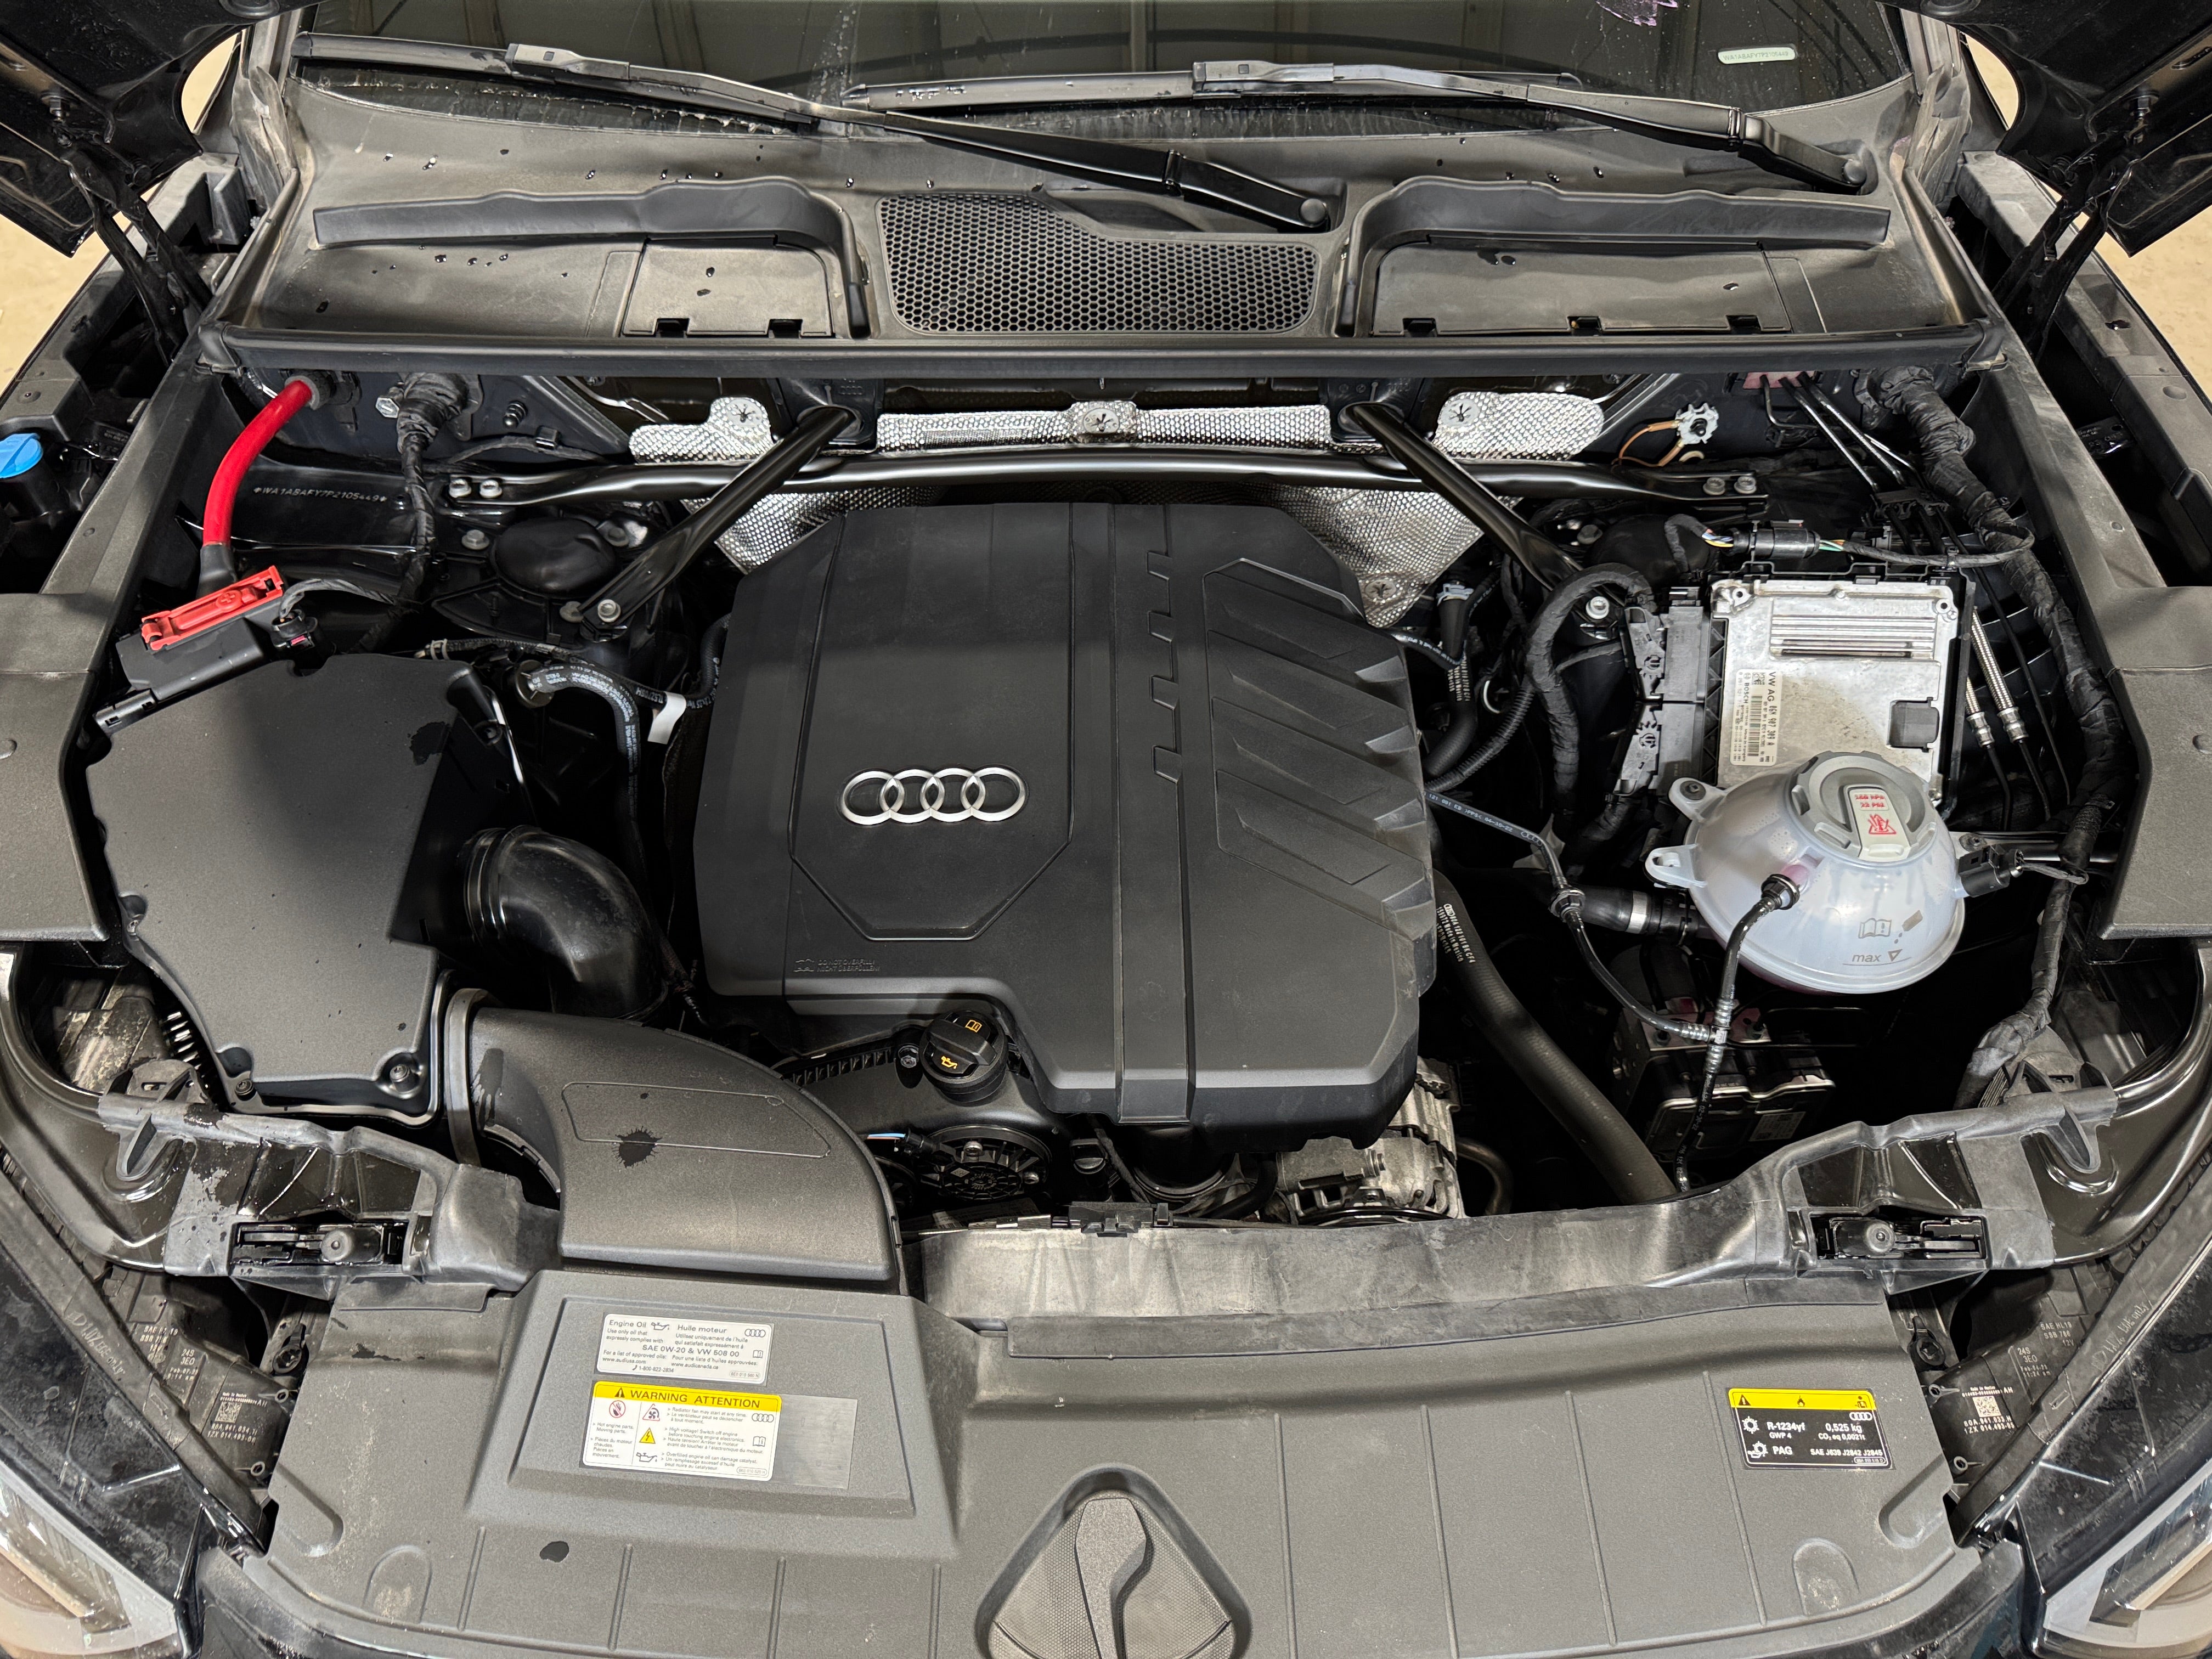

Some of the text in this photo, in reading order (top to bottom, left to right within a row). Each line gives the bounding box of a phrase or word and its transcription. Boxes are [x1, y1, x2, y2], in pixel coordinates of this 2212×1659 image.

[1768, 672, 1776, 686] VW
[1767, 689, 1775, 702] AG
[630, 1390, 760, 1408] WARNING ATTENTION
[1767, 1421, 1863, 1434] R-1234yf 0,525 kg
[1772, 1446, 1793, 1455] PAG
